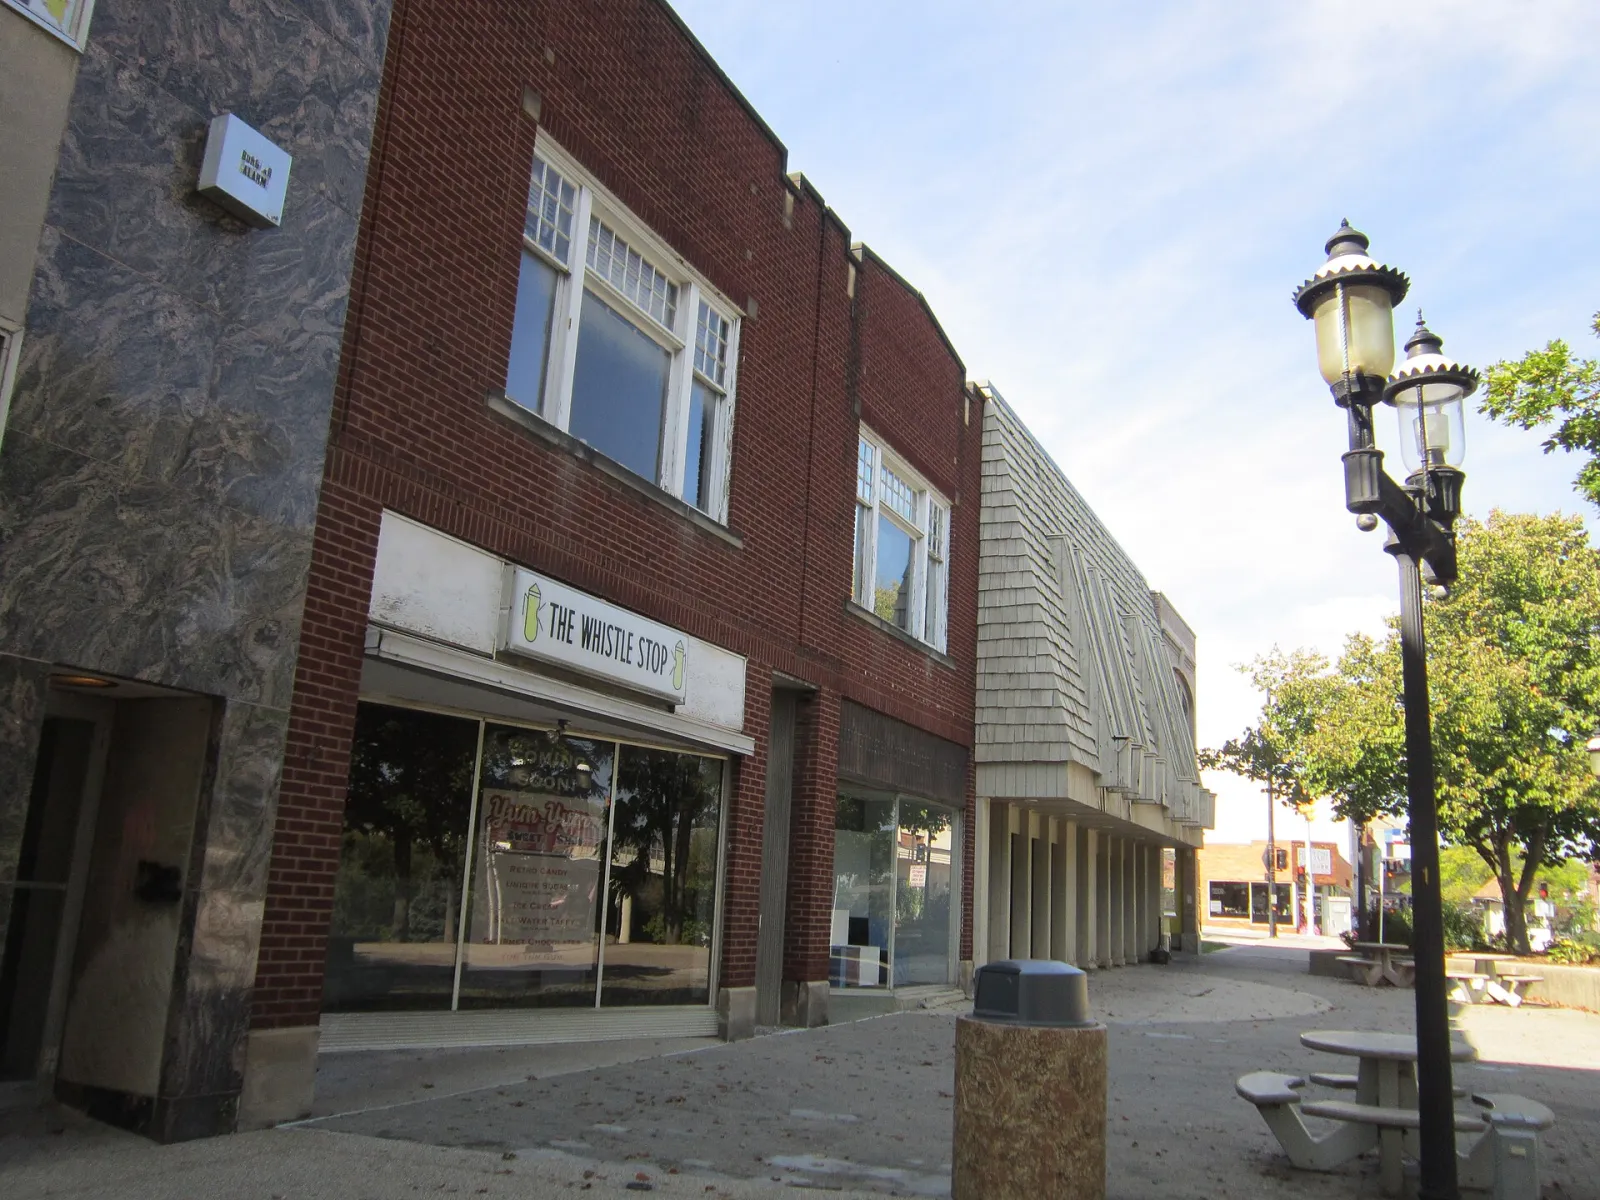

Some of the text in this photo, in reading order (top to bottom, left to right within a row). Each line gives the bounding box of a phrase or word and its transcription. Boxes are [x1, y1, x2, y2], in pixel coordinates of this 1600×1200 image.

[242, 165, 267, 189] ALARM
[550, 602, 668, 675] THE WHISTLE STOP
[509, 865, 568, 877] RETRO CANDY
[518, 916, 548, 926] WATER
